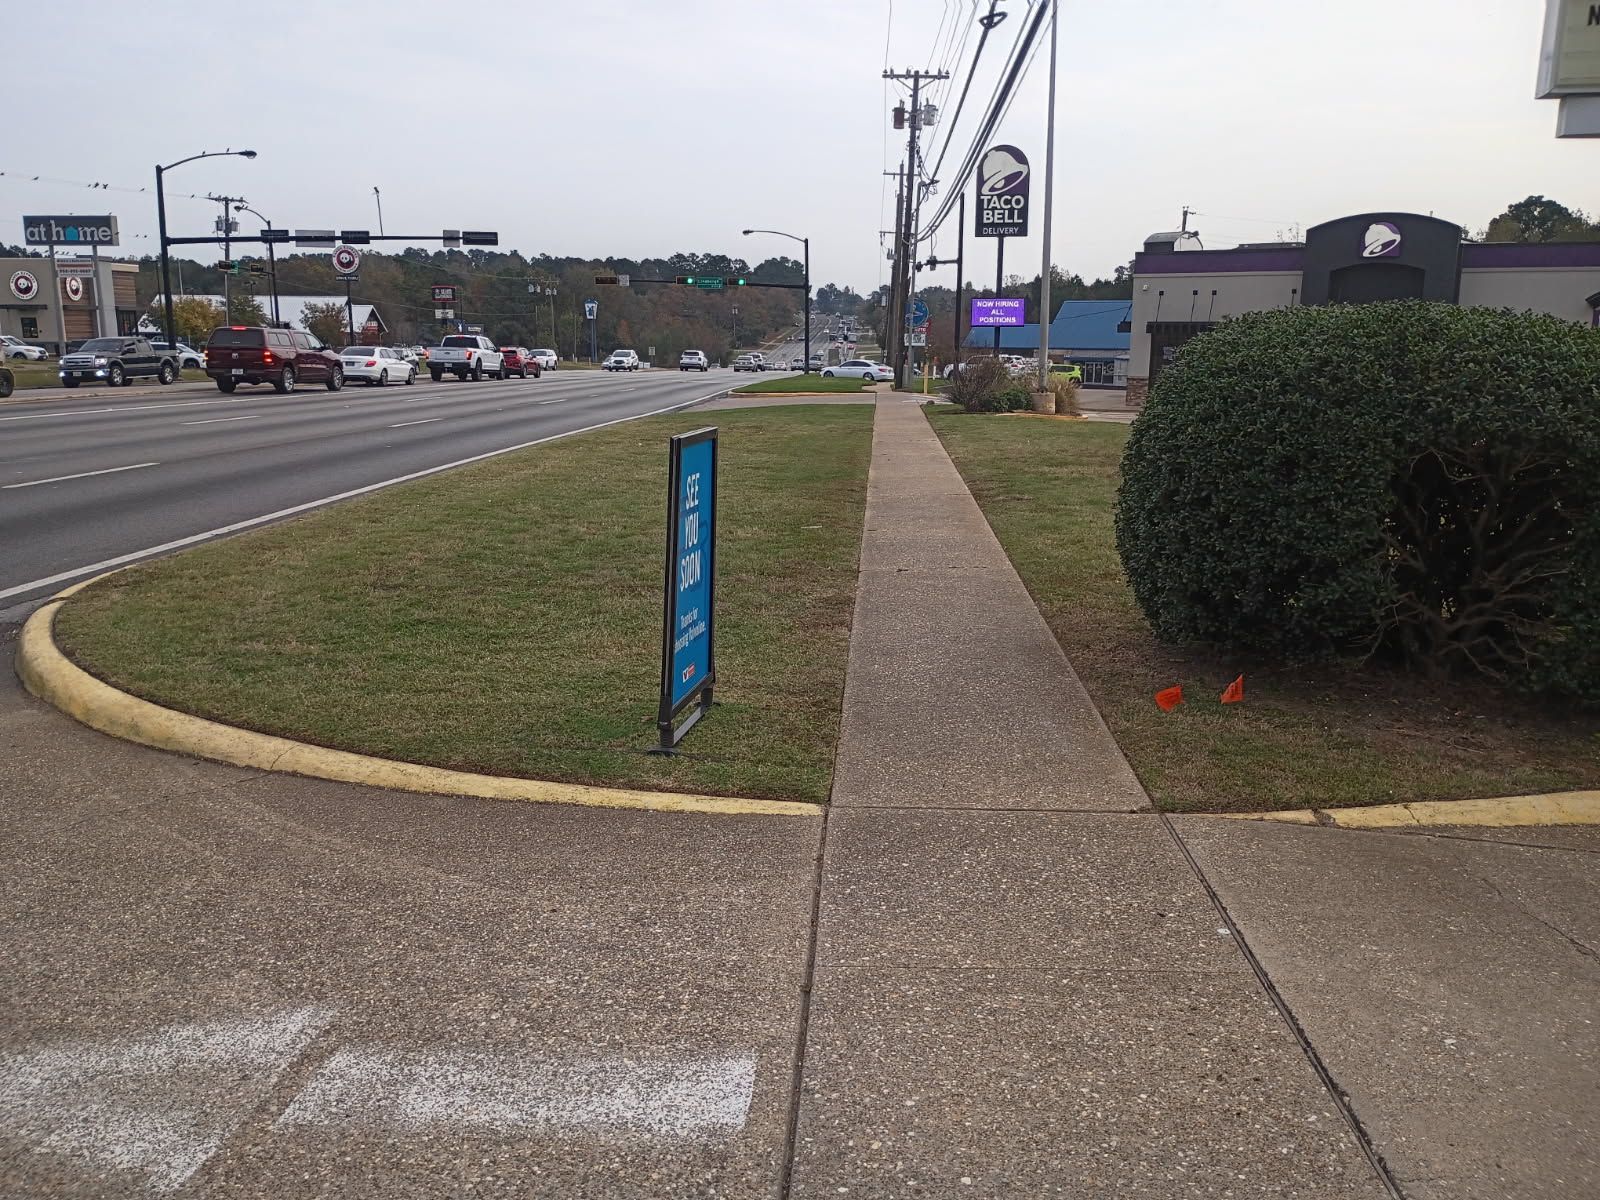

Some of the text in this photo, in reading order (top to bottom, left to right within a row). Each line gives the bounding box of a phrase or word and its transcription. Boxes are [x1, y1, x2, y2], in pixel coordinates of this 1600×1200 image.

[980, 195, 1025, 209] TACO
[983, 210, 1023, 224] BELL
[26, 223, 46, 241] at
[983, 227, 1019, 235] DELIVERY
[685, 472, 700, 510] SEE
[684, 512, 699, 550] YOU
[680, 549, 701, 592] SOON
